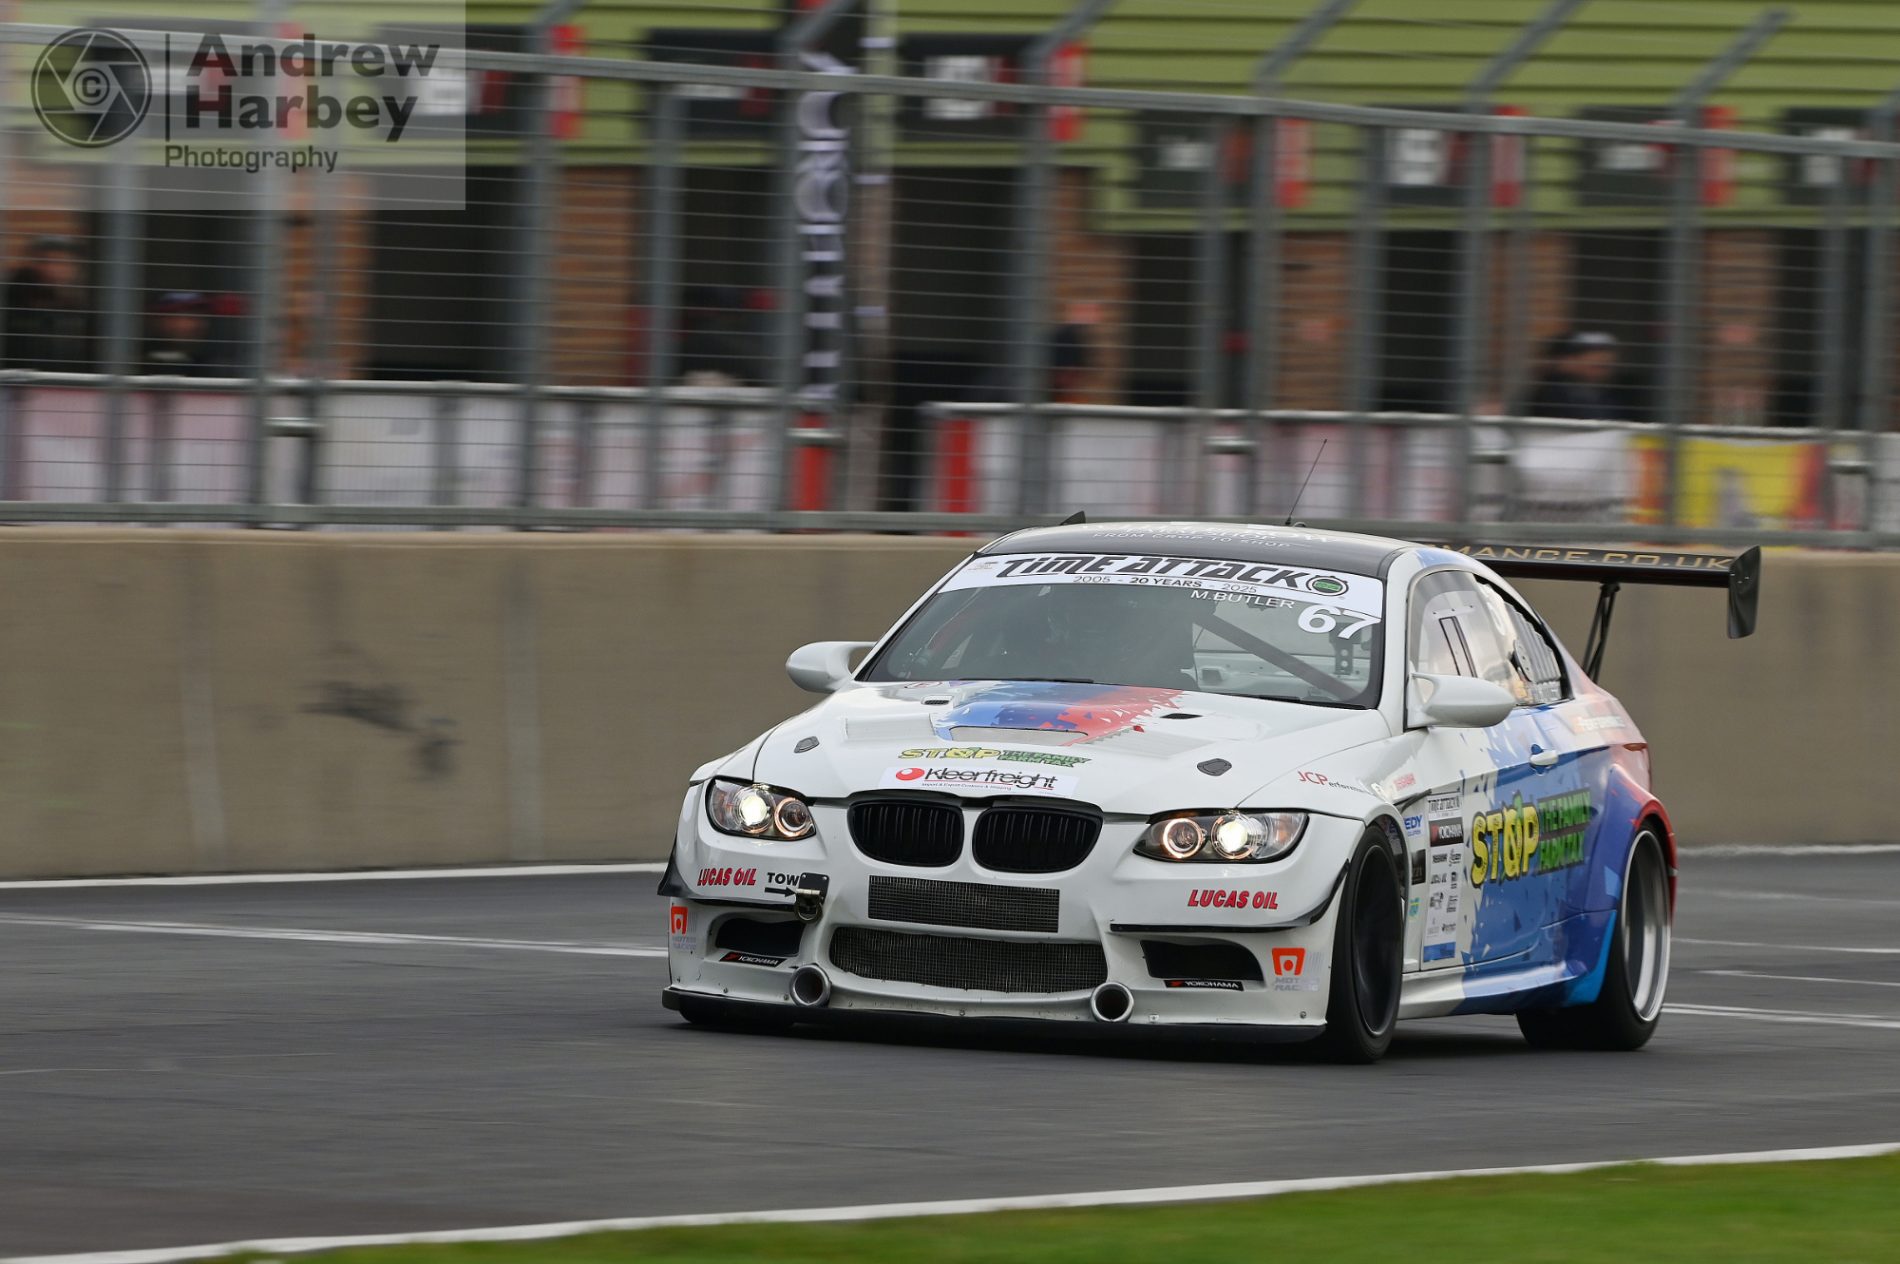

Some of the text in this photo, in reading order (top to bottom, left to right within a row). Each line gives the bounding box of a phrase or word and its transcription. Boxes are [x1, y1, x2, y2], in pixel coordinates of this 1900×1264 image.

[1426, 543, 1734, 569] MANCE.CO.UK
[1119, 557, 1310, 588] ATTACK
[1073, 575, 1112, 585] 2005
[1129, 577, 1150, 585] 20
[1152, 578, 1202, 588] YEARS
[1221, 583, 1257, 594] 2025
[1190, 589, 1295, 609] M.BUTLER
[1298, 603, 1382, 640] 67
[697, 867, 757, 887] LUCAS OIL
[767, 872, 800, 886] TOW
[1187, 889, 1279, 910] LUCAS OIL
[739, 955, 780, 966] YOKOHAMA
[1184, 980, 1239, 989] YOKOHAMA
